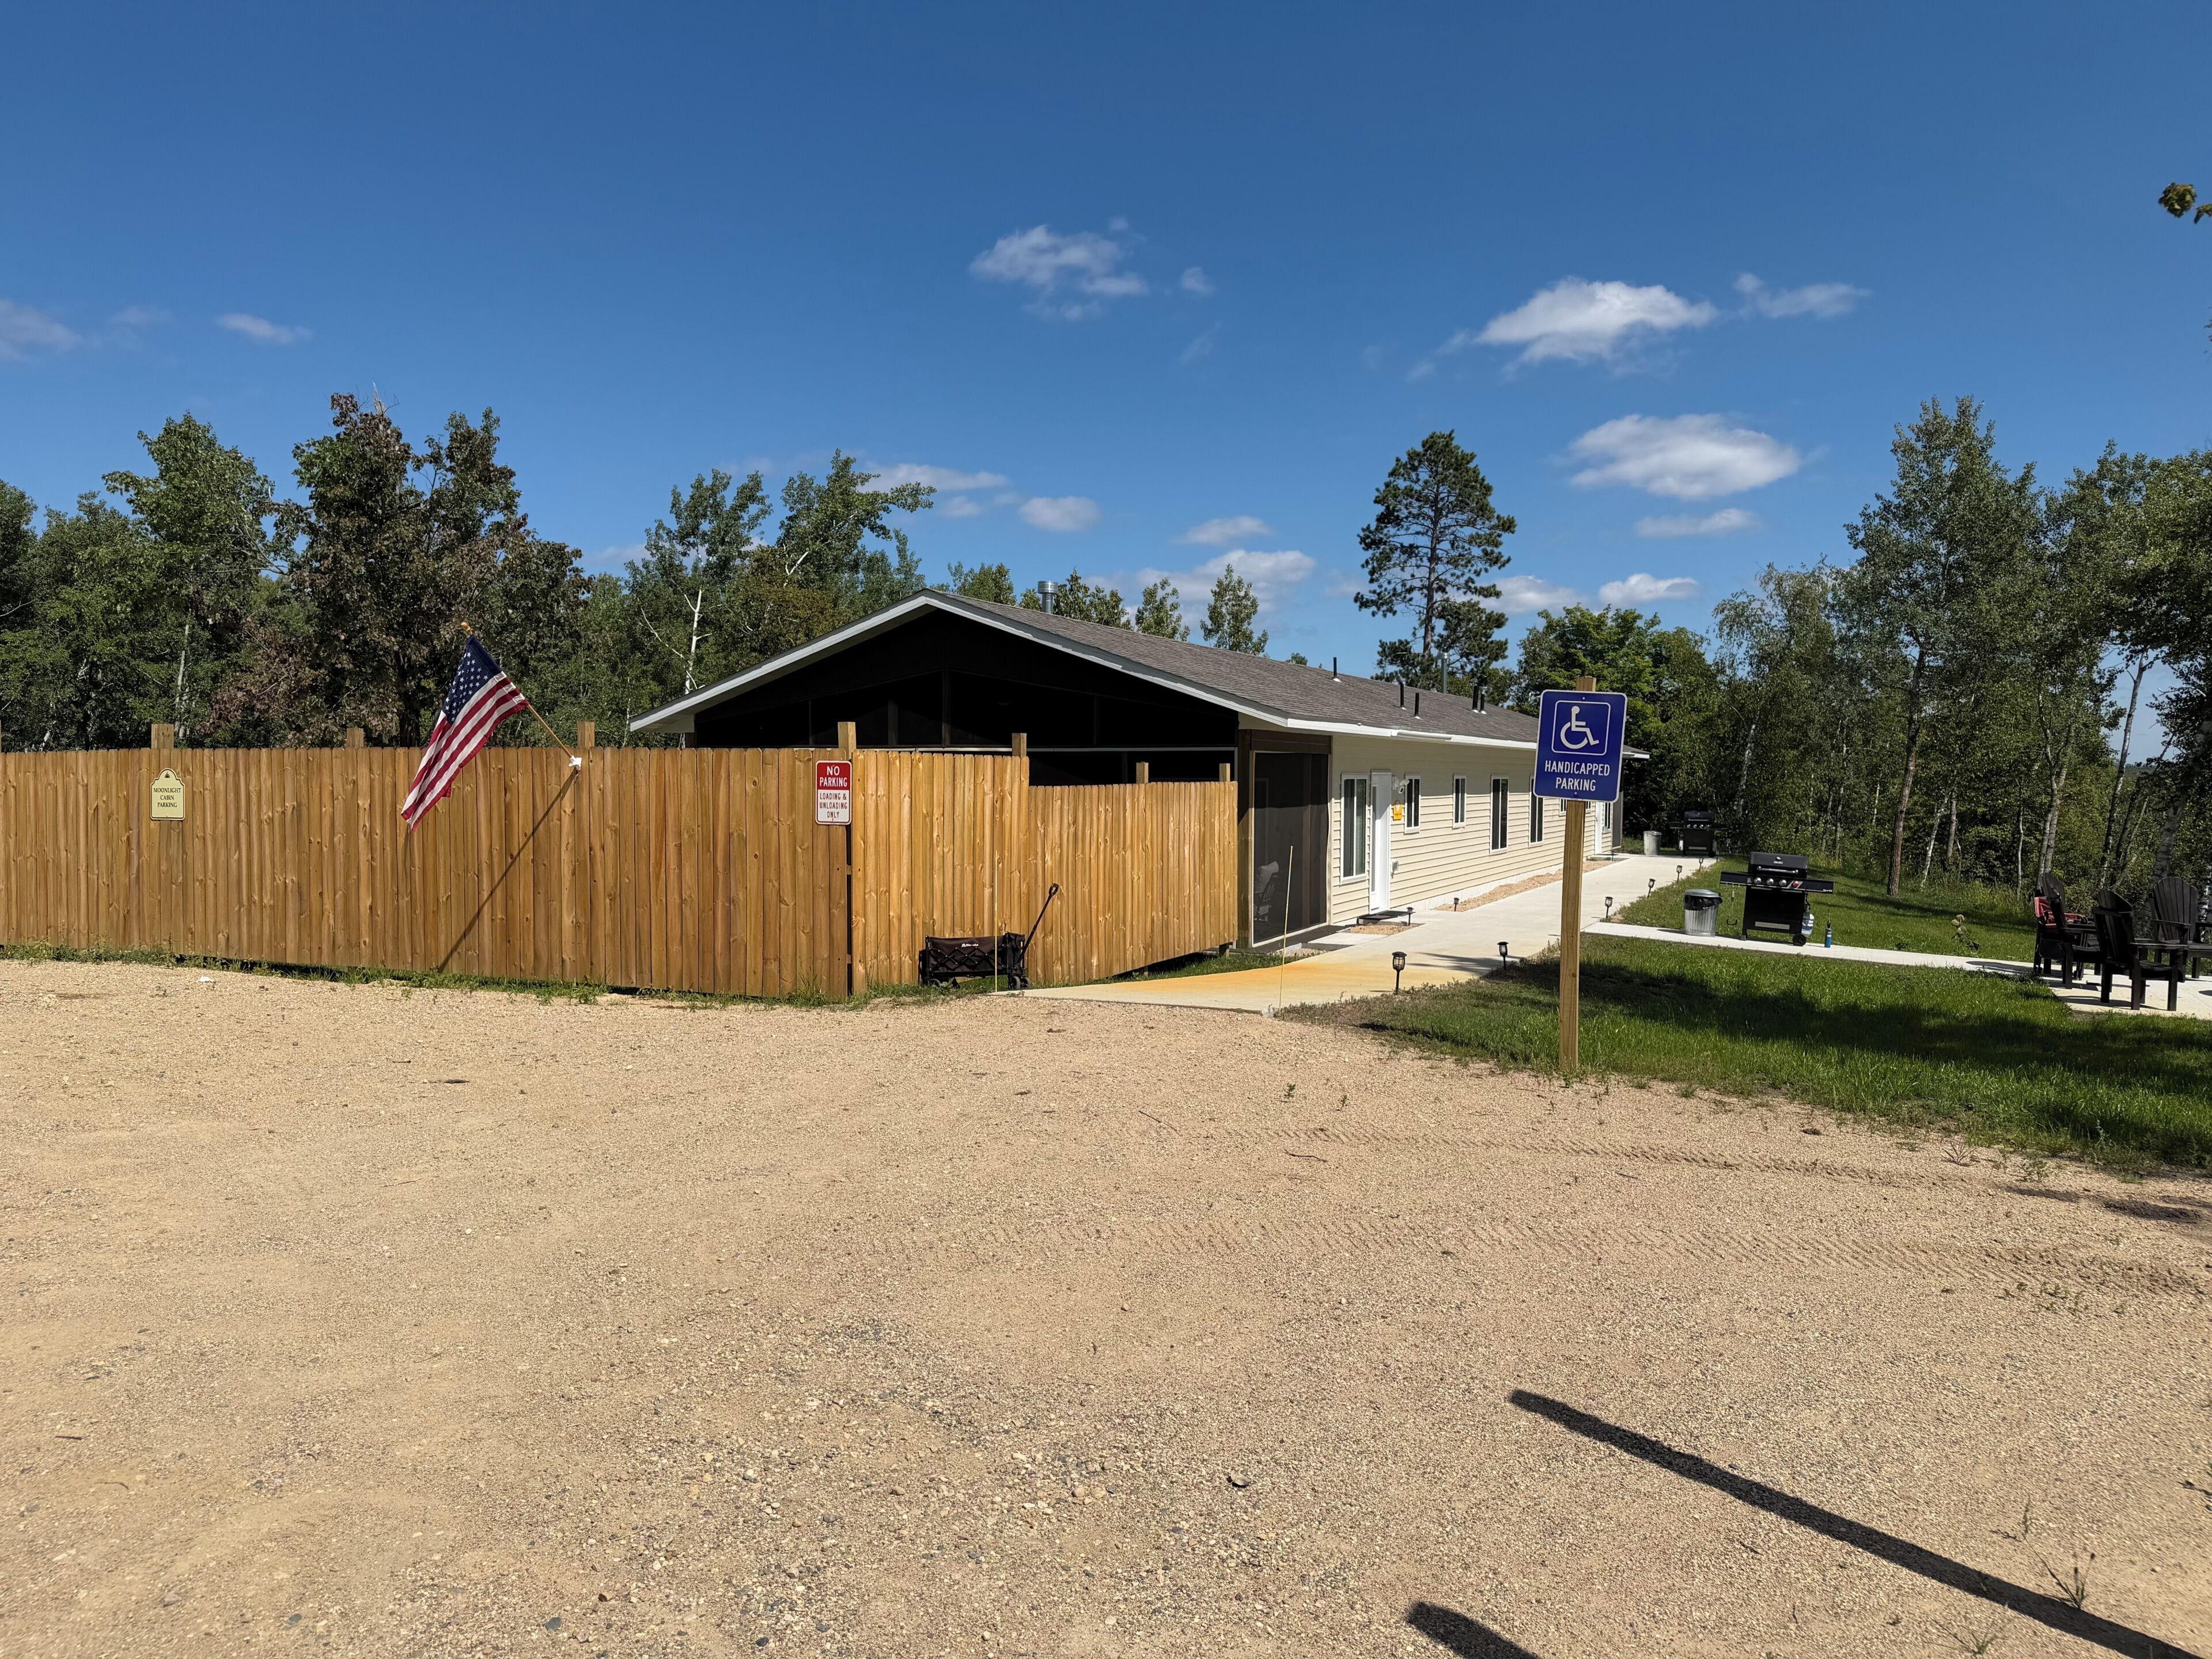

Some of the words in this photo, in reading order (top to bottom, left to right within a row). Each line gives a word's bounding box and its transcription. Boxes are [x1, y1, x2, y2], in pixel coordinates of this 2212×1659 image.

[827, 766, 840, 775] NO
[1544, 760, 1610, 776] HANDICAPPED
[820, 777, 847, 787] PARKING
[1555, 778, 1596, 791] PARKING
